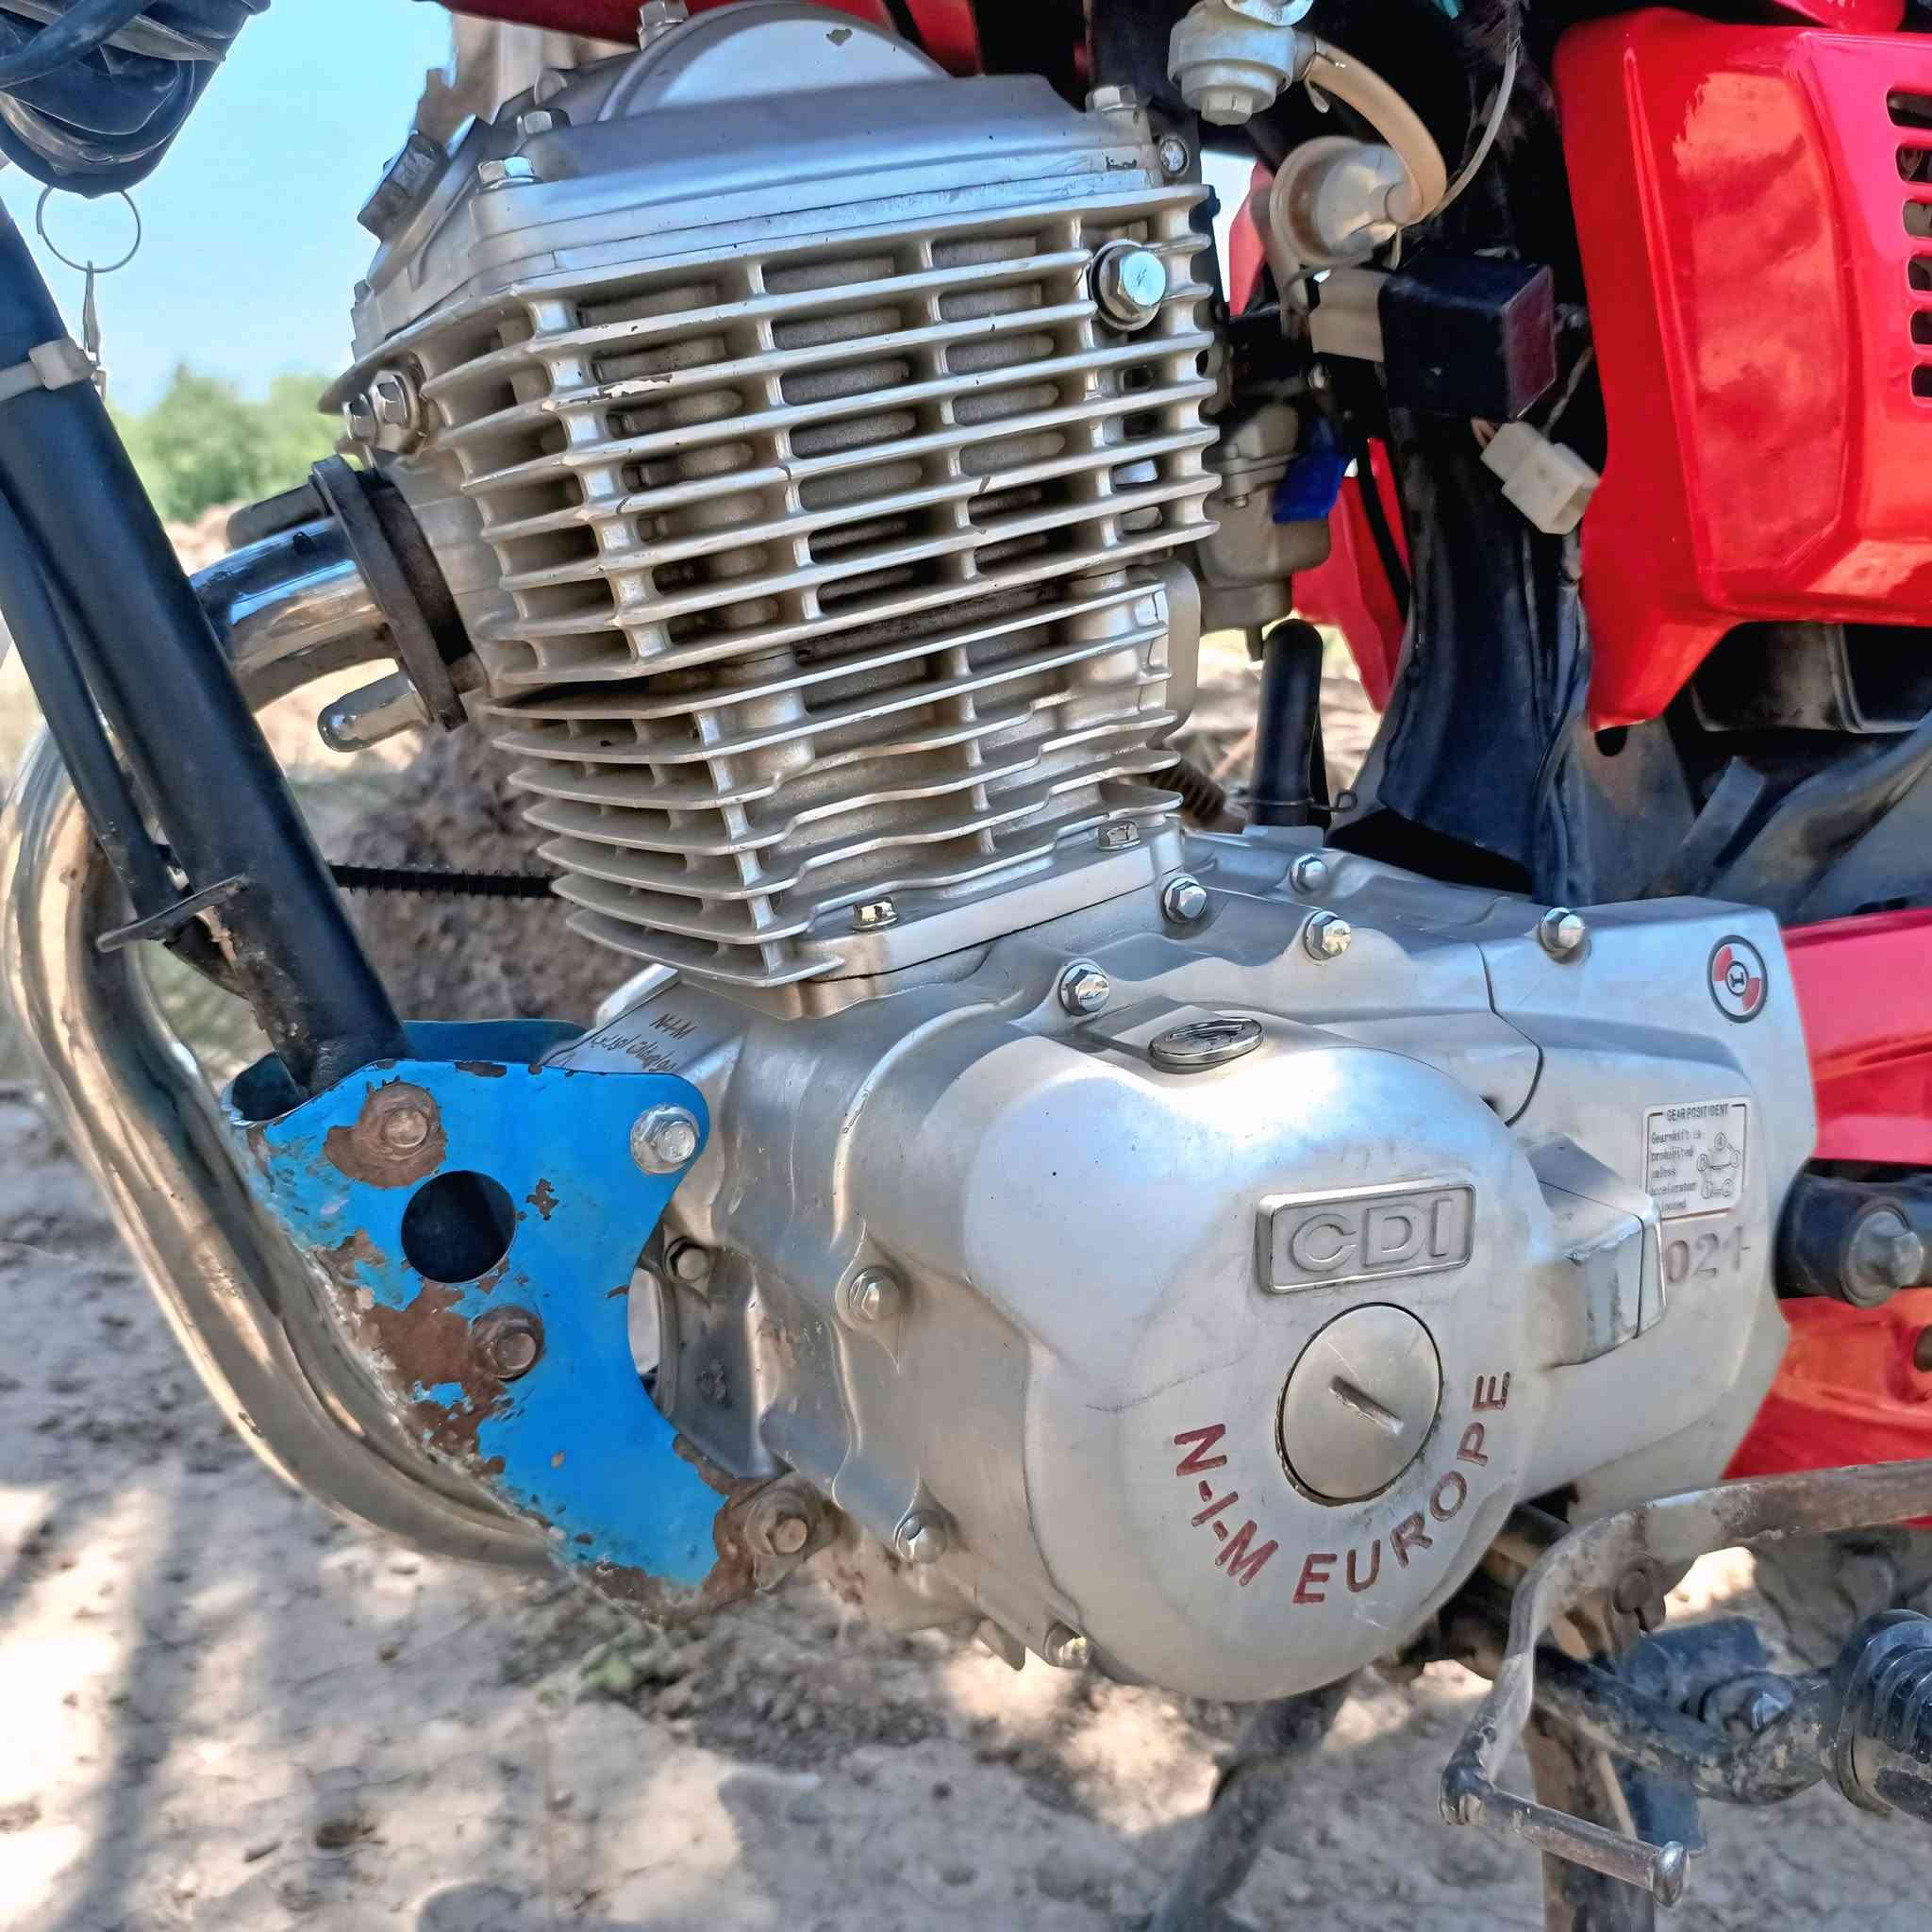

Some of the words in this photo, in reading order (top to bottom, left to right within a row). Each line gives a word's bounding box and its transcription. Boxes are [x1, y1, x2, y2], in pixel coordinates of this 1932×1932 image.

[1289, 1197, 1454, 1273] CDI
[1174, 1422, 1279, 1587] N-I-M
[1292, 1371, 1510, 1604] EUROPE
